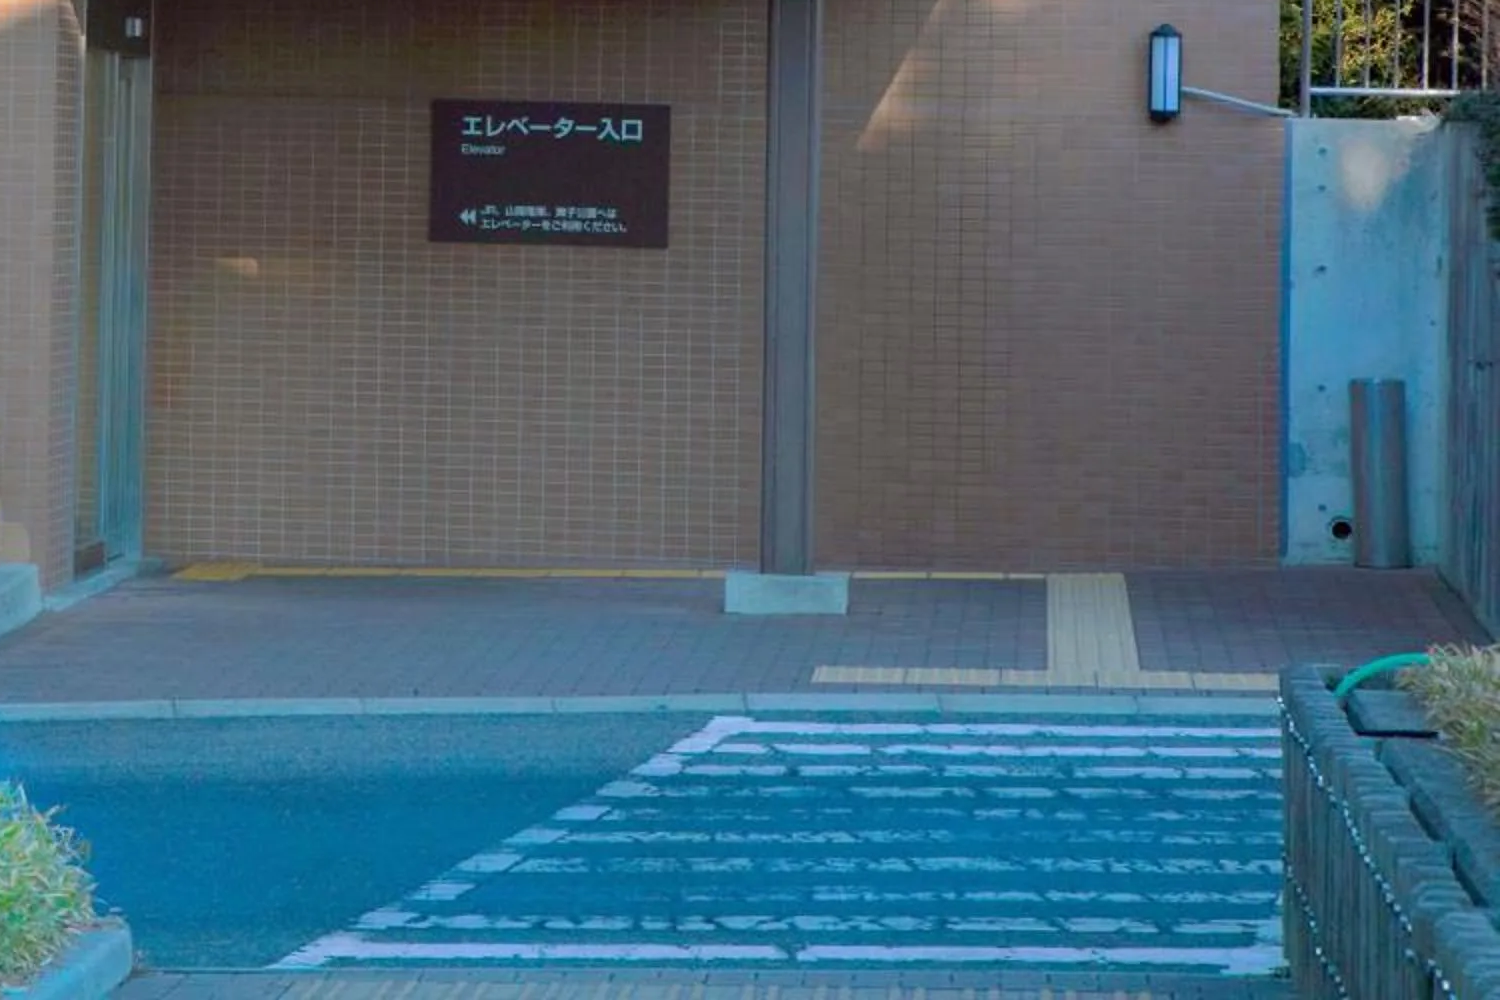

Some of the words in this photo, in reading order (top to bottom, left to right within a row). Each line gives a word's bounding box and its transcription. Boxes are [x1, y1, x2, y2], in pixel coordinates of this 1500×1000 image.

[461, 115, 643, 142] エレベーター入口
